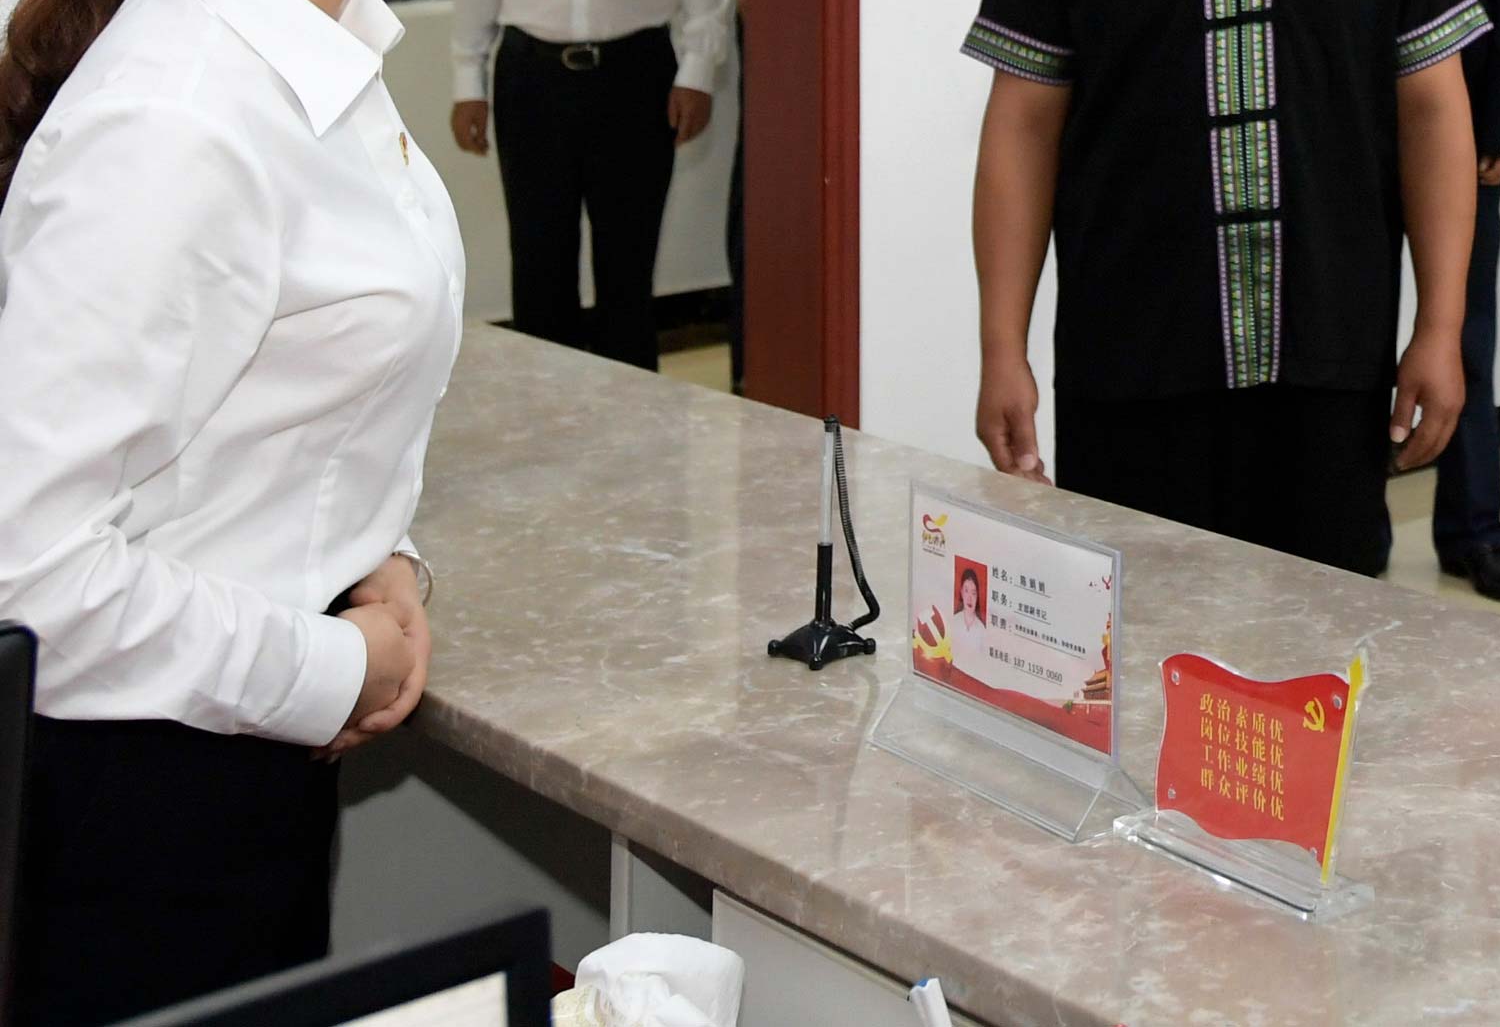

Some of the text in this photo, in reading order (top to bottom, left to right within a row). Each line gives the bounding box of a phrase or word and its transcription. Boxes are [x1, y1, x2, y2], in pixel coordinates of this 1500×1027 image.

[1200, 693, 1284, 743] 政治素质优
[1201, 716, 1284, 769] 岗位技能优
[1201, 768, 1284, 821] 群众评价优
[1203, 744, 1284, 795] 工作业绩优
